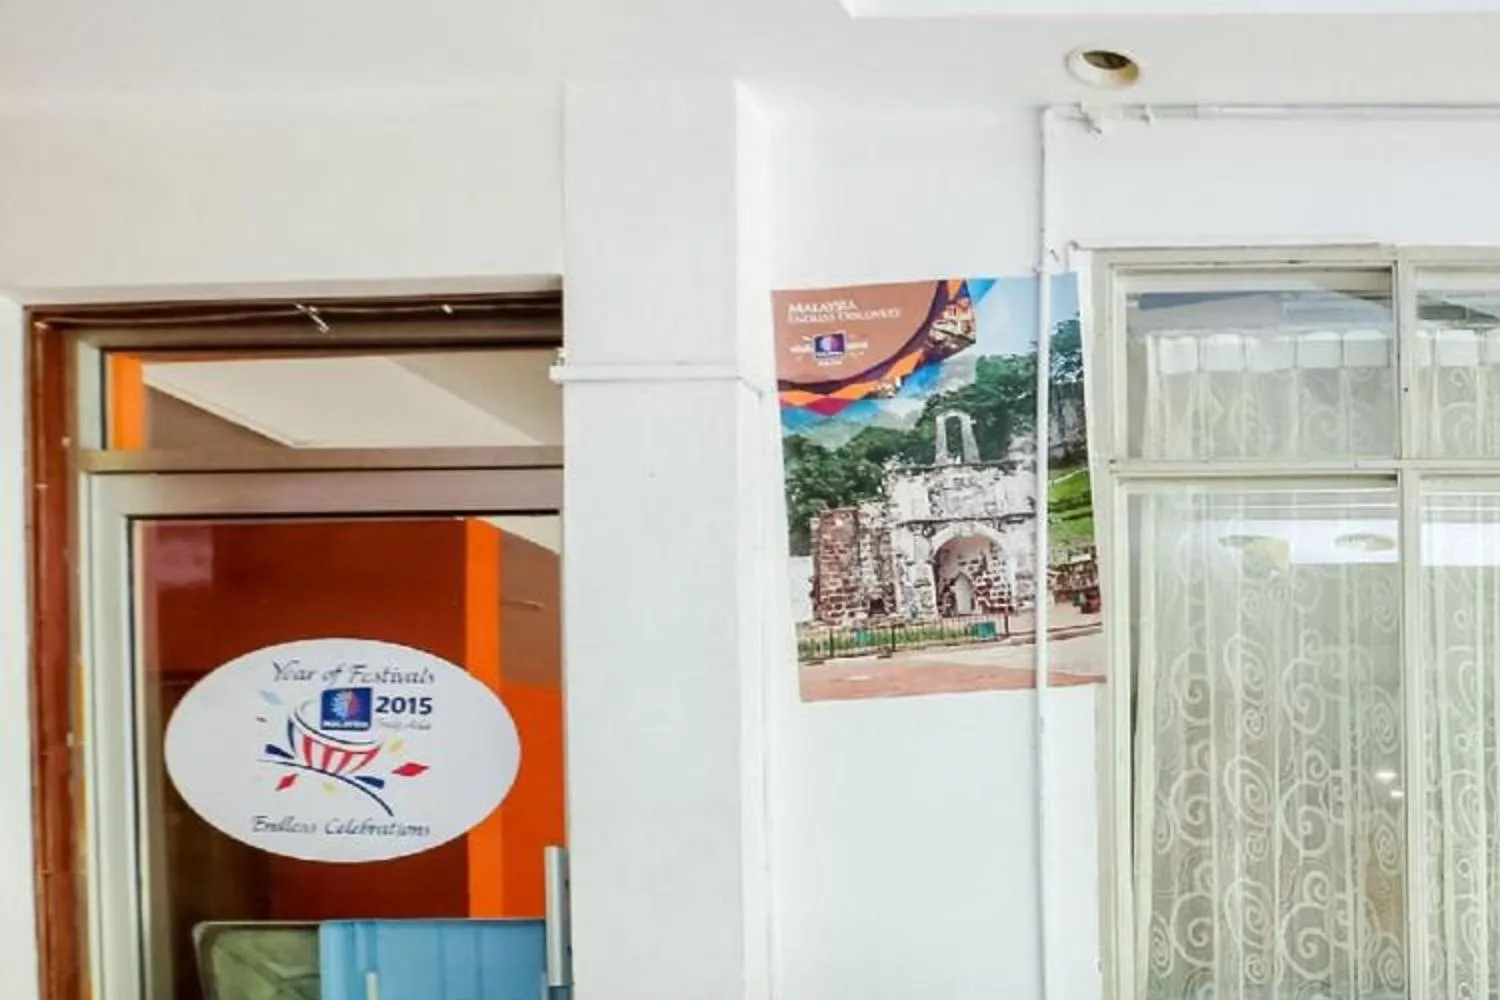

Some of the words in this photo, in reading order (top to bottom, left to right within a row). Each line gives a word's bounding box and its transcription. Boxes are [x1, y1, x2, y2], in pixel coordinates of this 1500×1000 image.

[272, 660, 316, 682] Year
[322, 661, 346, 685] of
[349, 664, 435, 685] Festivals
[376, 696, 433, 715] 2015
[324, 816, 430, 836] Celebrations
